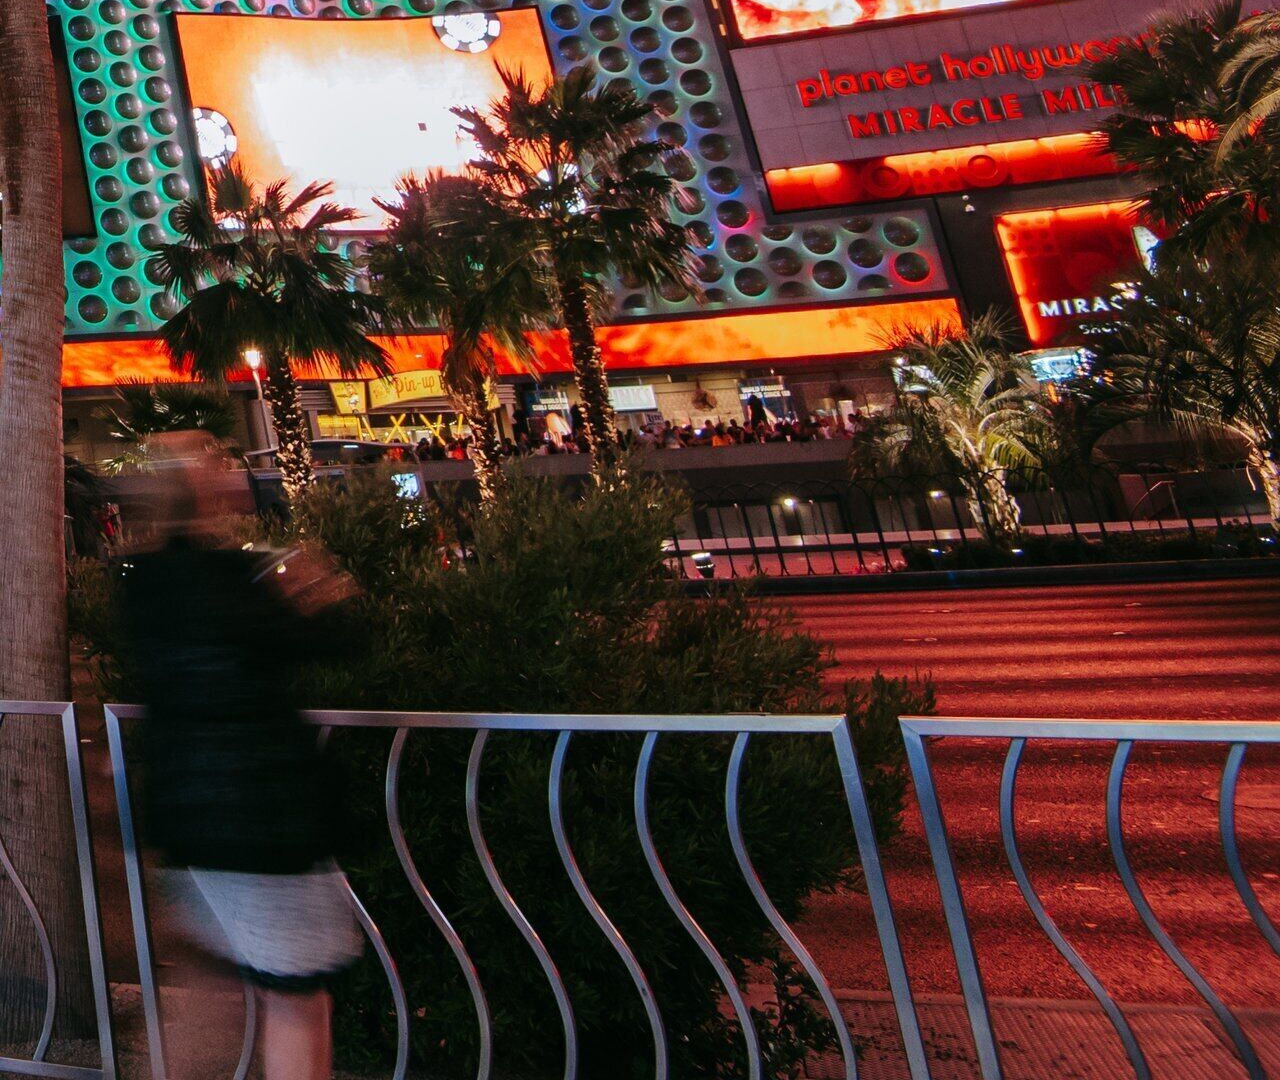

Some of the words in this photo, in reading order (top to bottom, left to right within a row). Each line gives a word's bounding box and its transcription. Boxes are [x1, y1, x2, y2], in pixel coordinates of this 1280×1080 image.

[795, 61, 933, 108] planet
[846, 93, 1024, 140] MIRACLE
[394, 375, 436, 399] Pin-up
